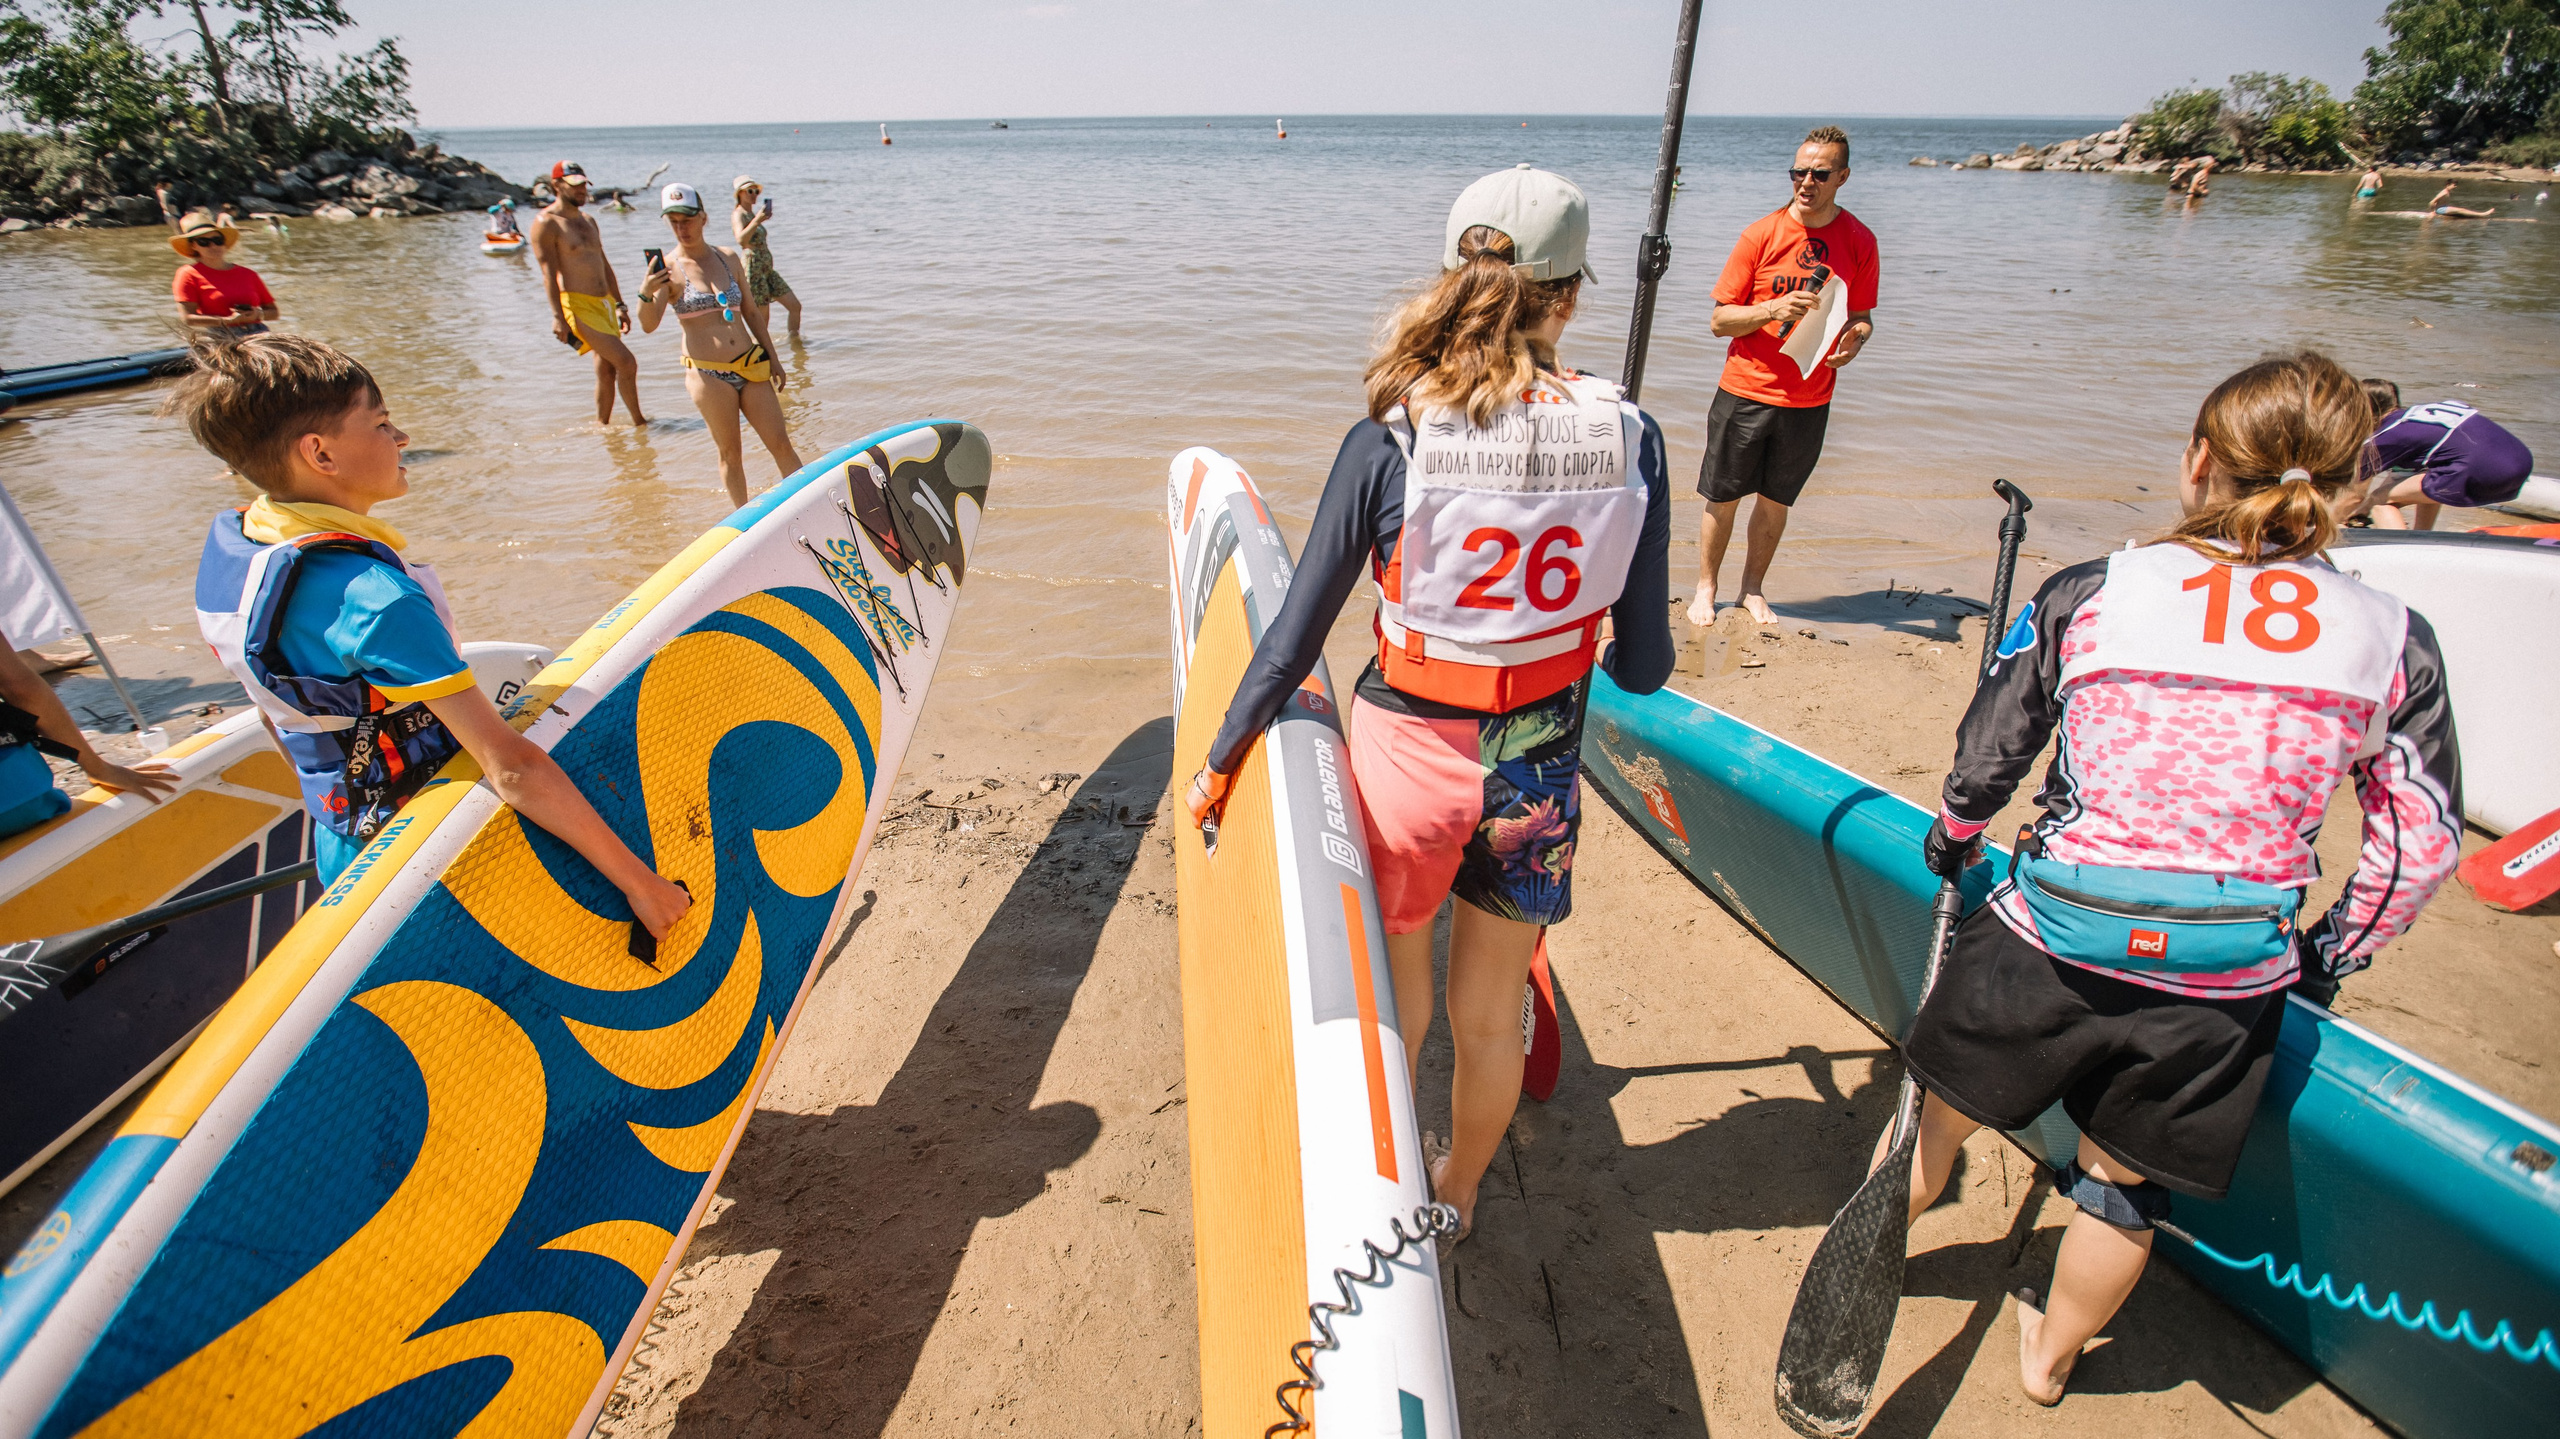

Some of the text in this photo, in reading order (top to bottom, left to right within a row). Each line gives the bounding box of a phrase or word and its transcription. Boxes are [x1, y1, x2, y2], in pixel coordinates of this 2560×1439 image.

[1425, 449, 1615, 477] ШКОЛА ПАРУСНОГО СПОРТА
[1454, 525, 1584, 612] 26
[2182, 563, 2320, 653] 18
[320, 816, 415, 907] THICKNESS
[2131, 933, 2164, 953] red
